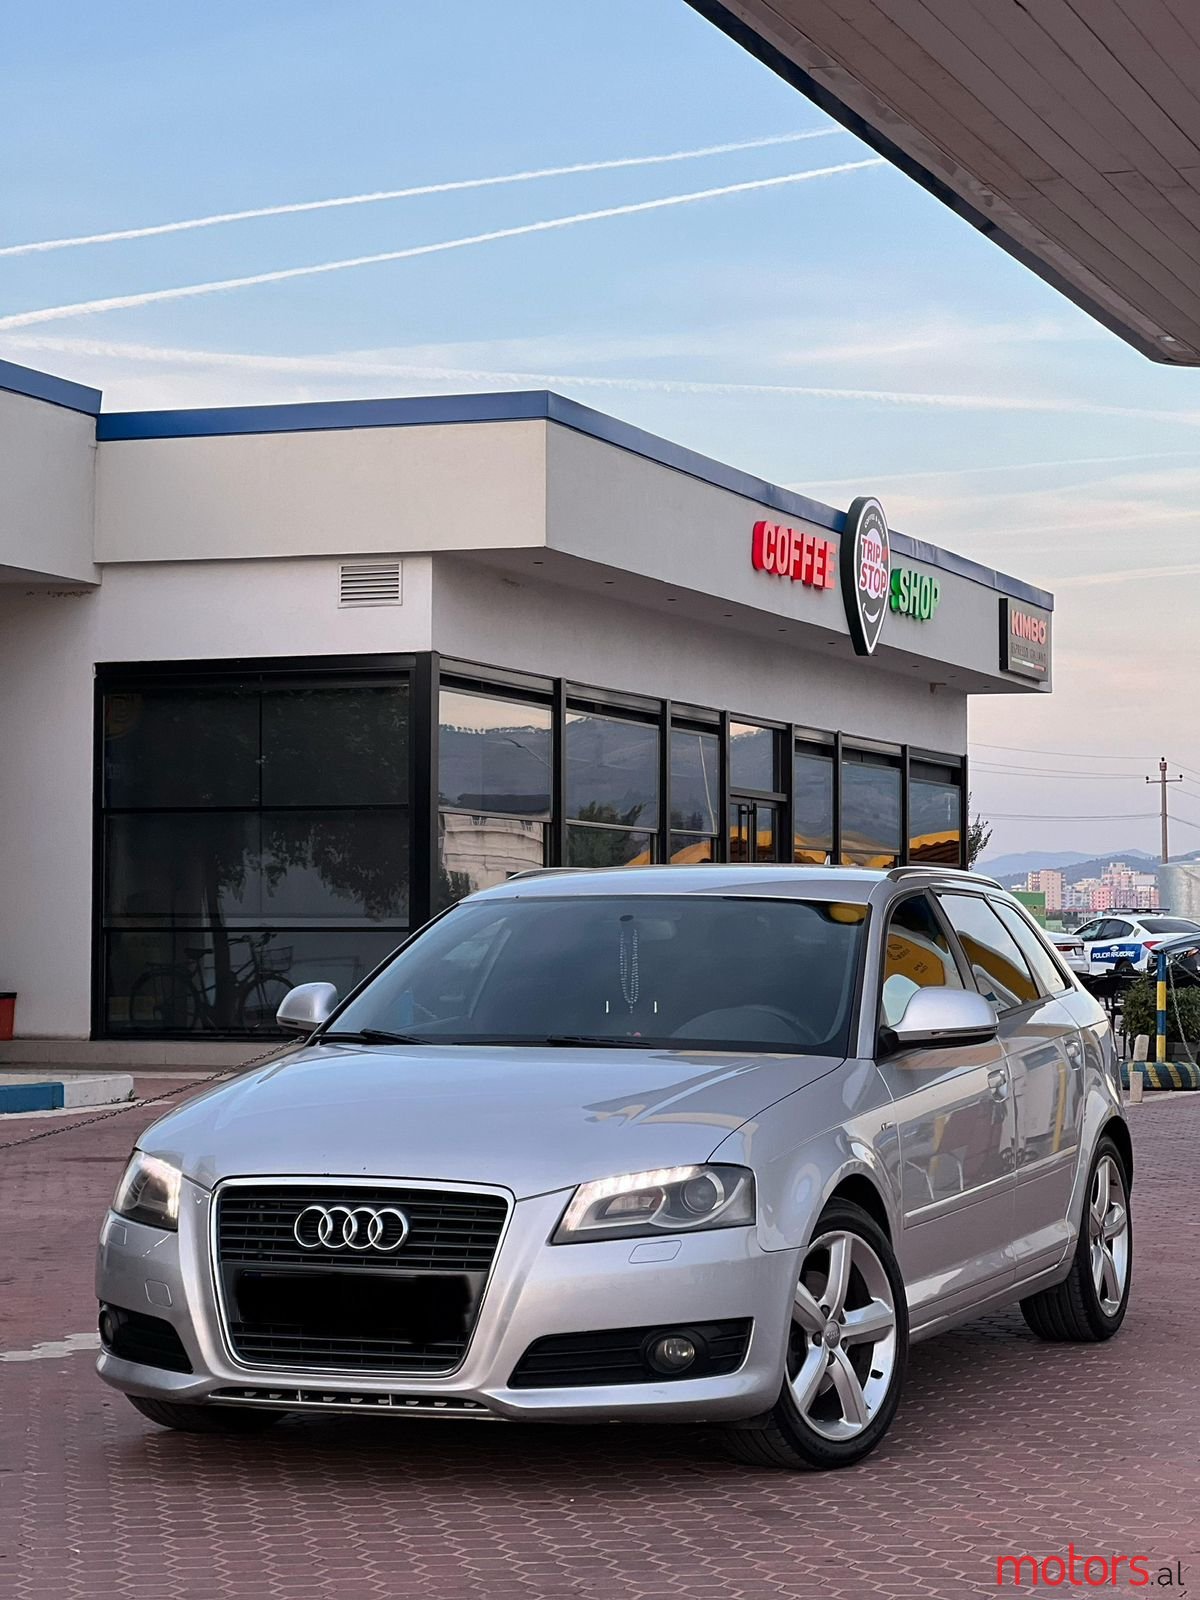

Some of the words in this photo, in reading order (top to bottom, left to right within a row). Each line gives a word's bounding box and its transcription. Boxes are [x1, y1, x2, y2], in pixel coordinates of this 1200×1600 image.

[861, 535, 881, 564] TRIP
[753, 521, 837, 589] COFFEE
[890, 568, 941, 620] SHOP
[860, 562, 888, 597] STOP
[1011, 609, 1047, 645] KIMBO
